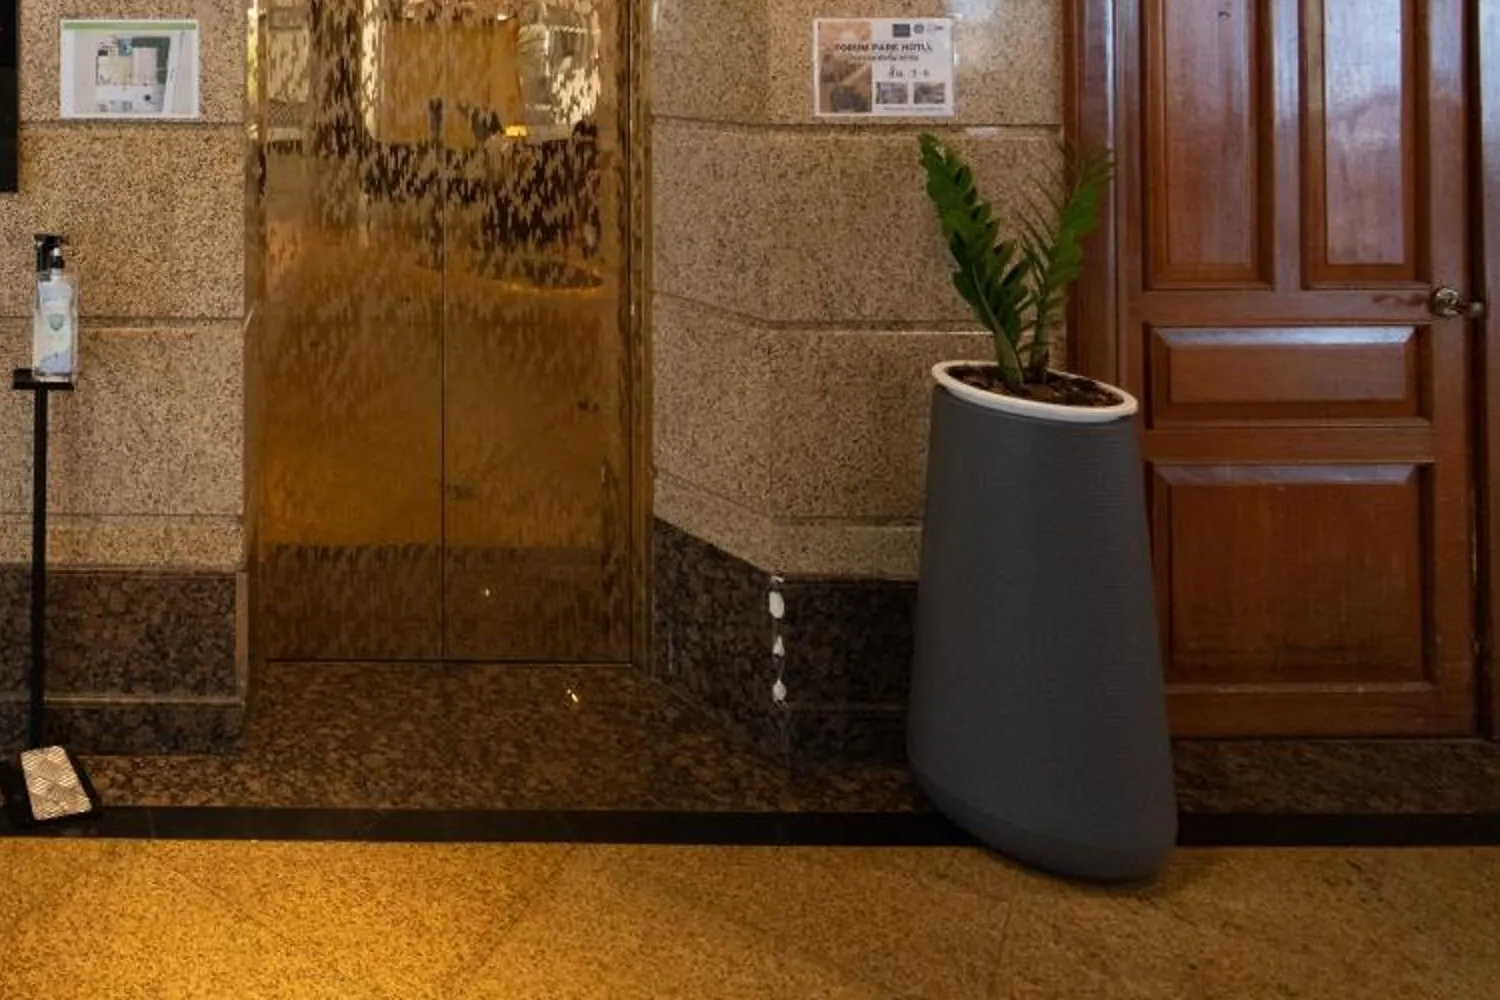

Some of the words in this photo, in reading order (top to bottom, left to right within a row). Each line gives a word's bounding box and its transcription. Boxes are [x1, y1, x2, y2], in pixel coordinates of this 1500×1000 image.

[835, 43, 869, 52] FORUM
[871, 43, 899, 51] PARK
[901, 42, 933, 52] HOTEL
